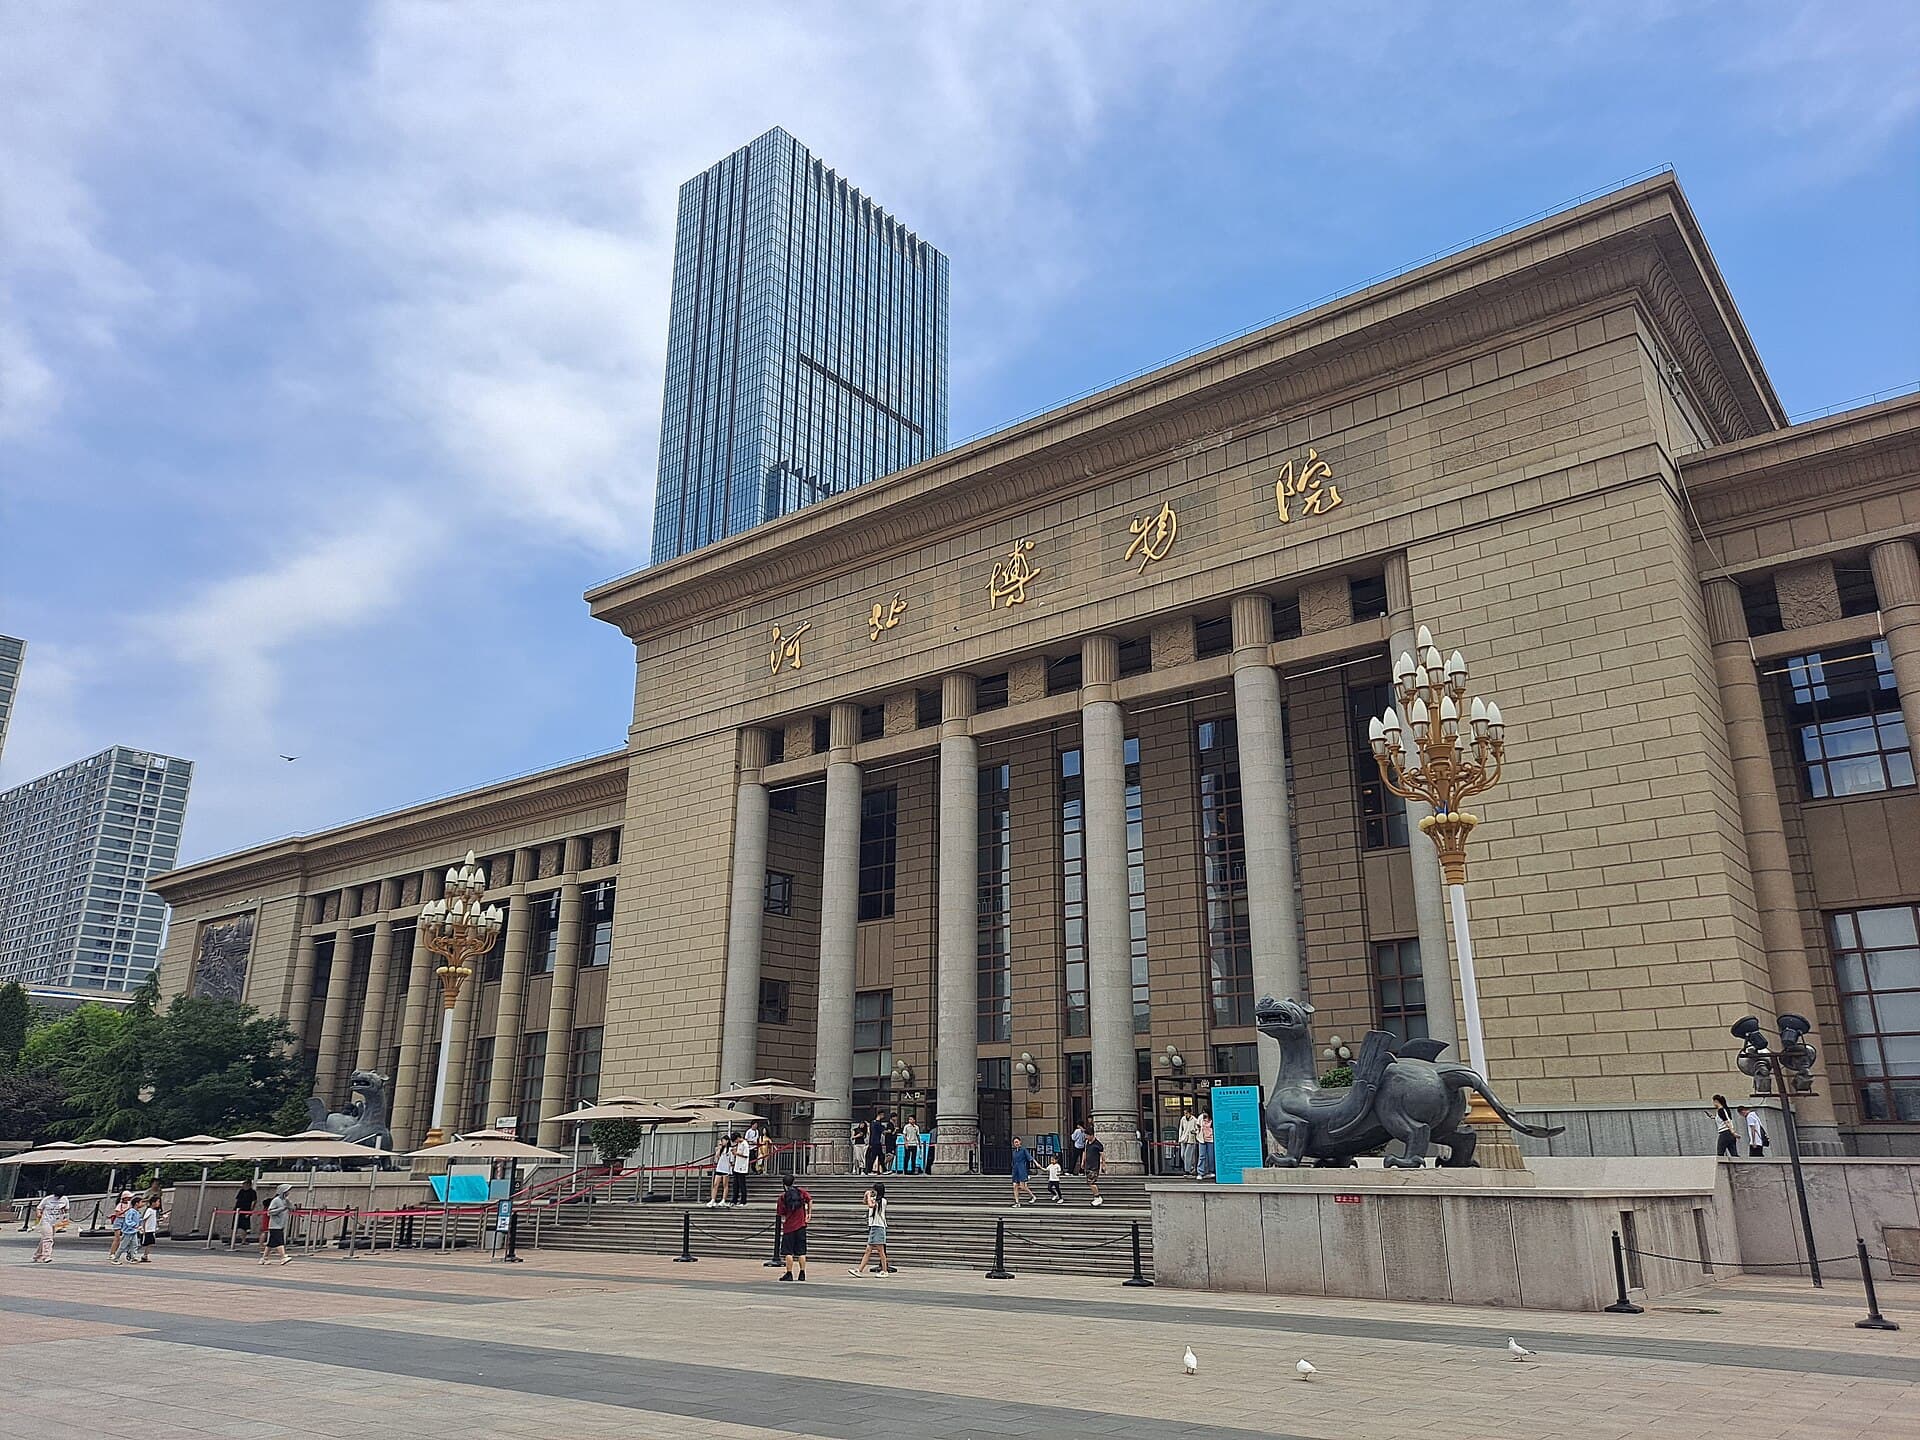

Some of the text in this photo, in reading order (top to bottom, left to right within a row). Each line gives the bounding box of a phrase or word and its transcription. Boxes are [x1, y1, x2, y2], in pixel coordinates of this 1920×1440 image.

[770, 447, 1343, 675] 河北博物院
